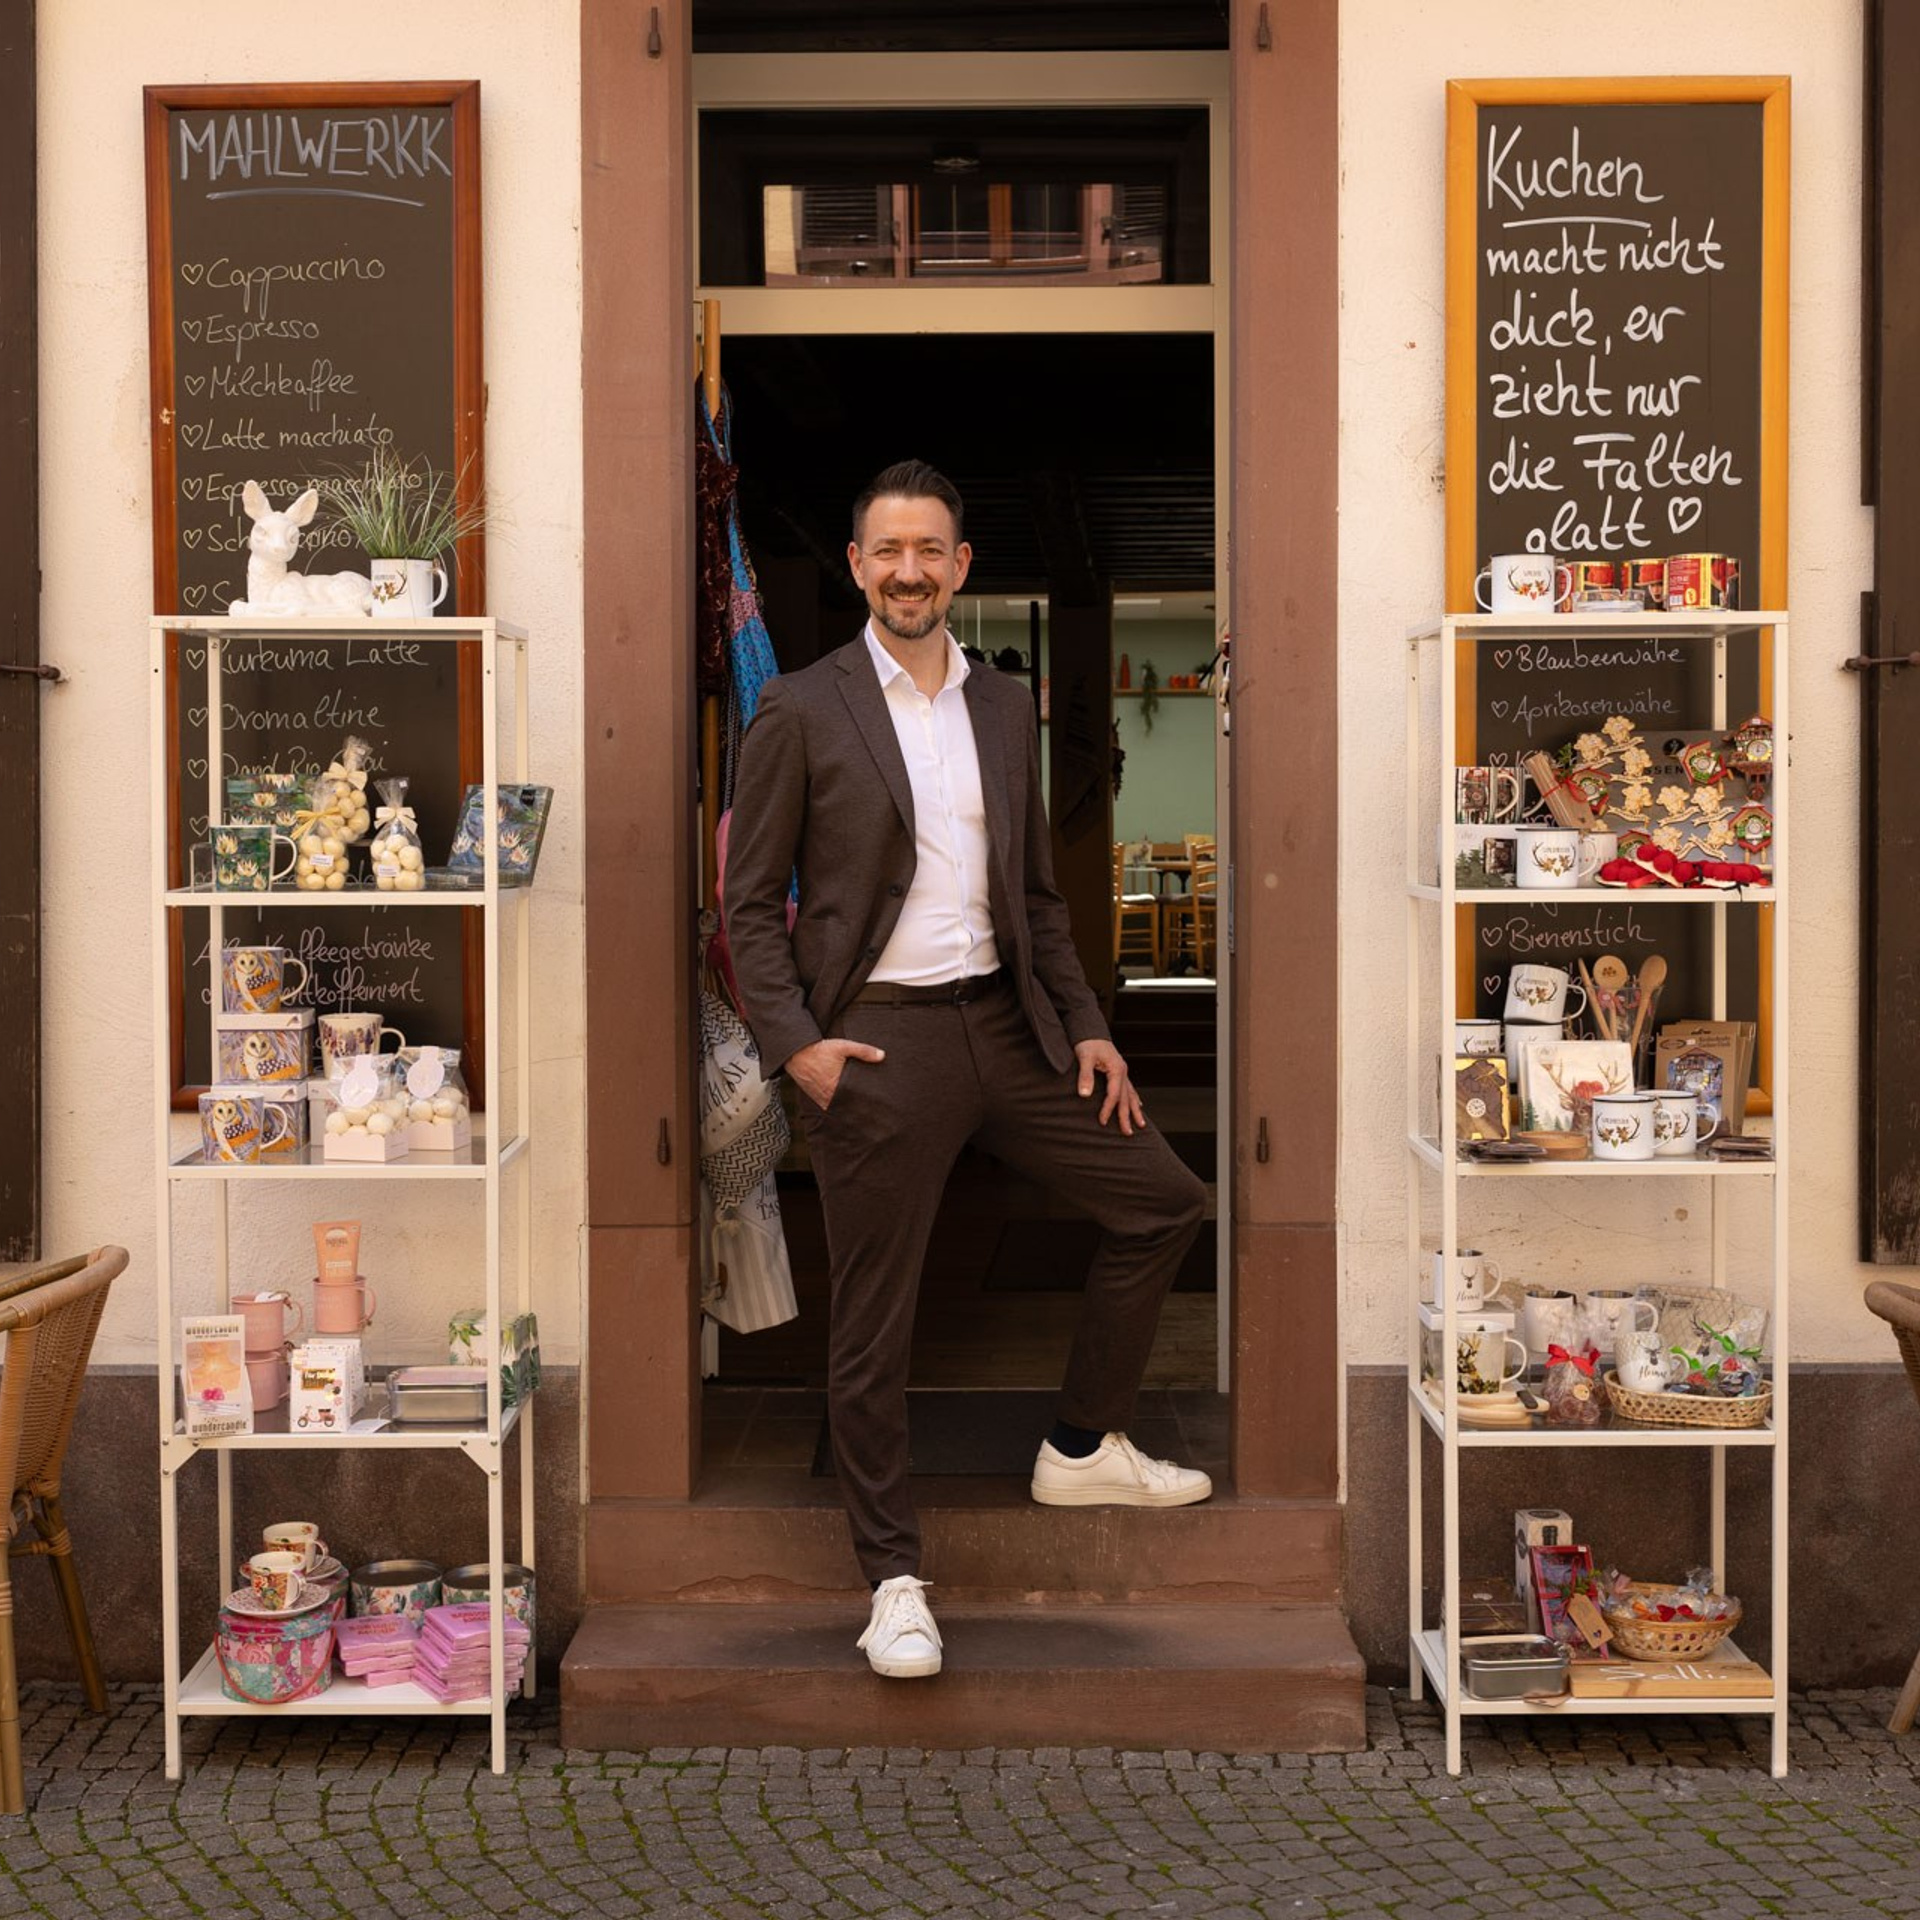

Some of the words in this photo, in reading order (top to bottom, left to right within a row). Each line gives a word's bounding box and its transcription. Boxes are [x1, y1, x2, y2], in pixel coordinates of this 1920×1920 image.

[179, 112, 452, 181] MAHLWERKK
[1487, 124, 1664, 211] Kuchen
[1486, 224, 1607, 277] macht
[1619, 216, 1725, 275] nicht
[206, 257, 385, 320] Cappuccino
[206, 314, 319, 363] Espresso
[1489, 288, 1611, 355] dick,
[1623, 305, 1686, 343] er
[210, 359, 358, 411] Milchkaffee
[1489, 354, 1612, 418] zieht
[1627, 375, 1702, 417] nur
[202, 418, 270, 451] Latte
[279, 413, 394, 446] macchiato
[1489, 435, 1564, 494] die
[1573, 431, 1742, 491] Falten
[206, 473, 300, 517] Espesso
[1512, 687, 1681, 738] Aprikosenwähe
[1505, 906, 1657, 952] Bienenstich
